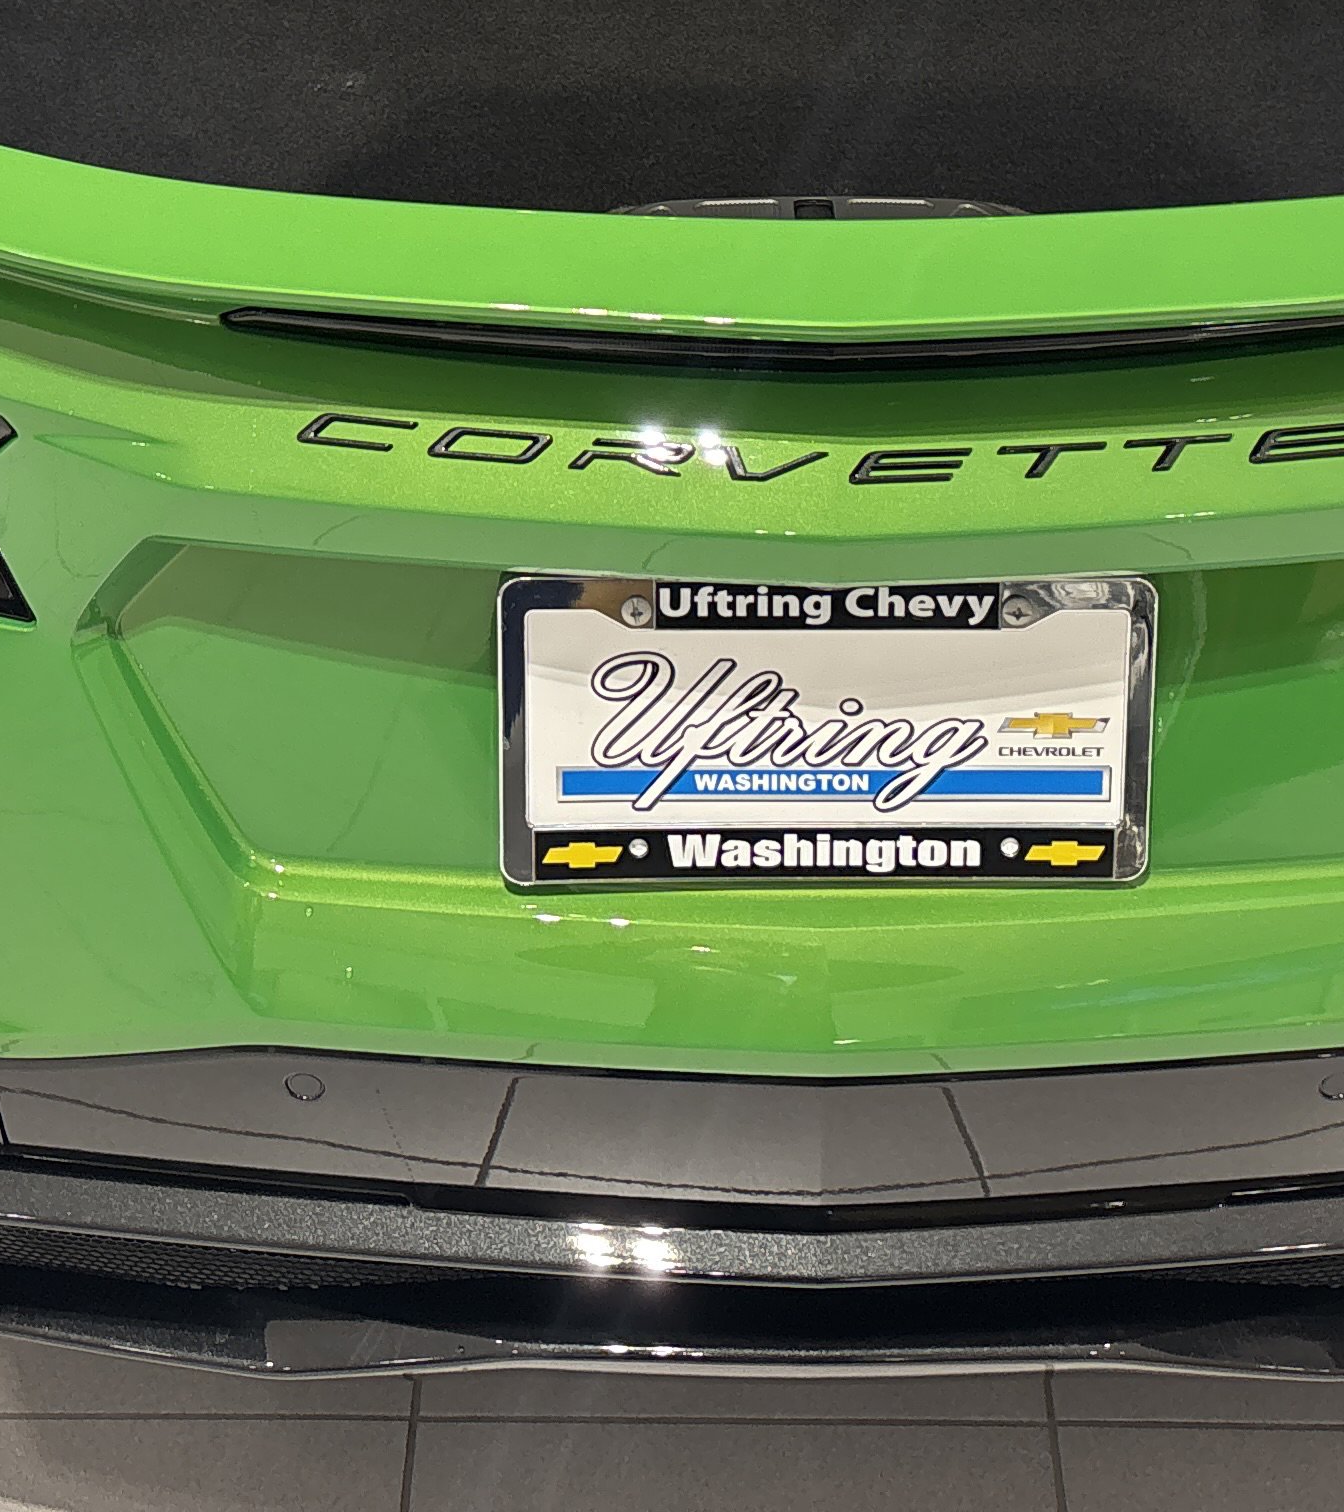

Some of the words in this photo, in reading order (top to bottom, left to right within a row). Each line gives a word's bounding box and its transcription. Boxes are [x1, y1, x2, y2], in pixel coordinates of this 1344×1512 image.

[658, 586, 833, 626] Uftring
[844, 586, 996, 627] Chevy
[590, 650, 989, 813] Uftring
[997, 746, 1105, 758] CHEVROLET
[694, 772, 870, 792] WASHINGTON
[666, 833, 982, 873] Washington
